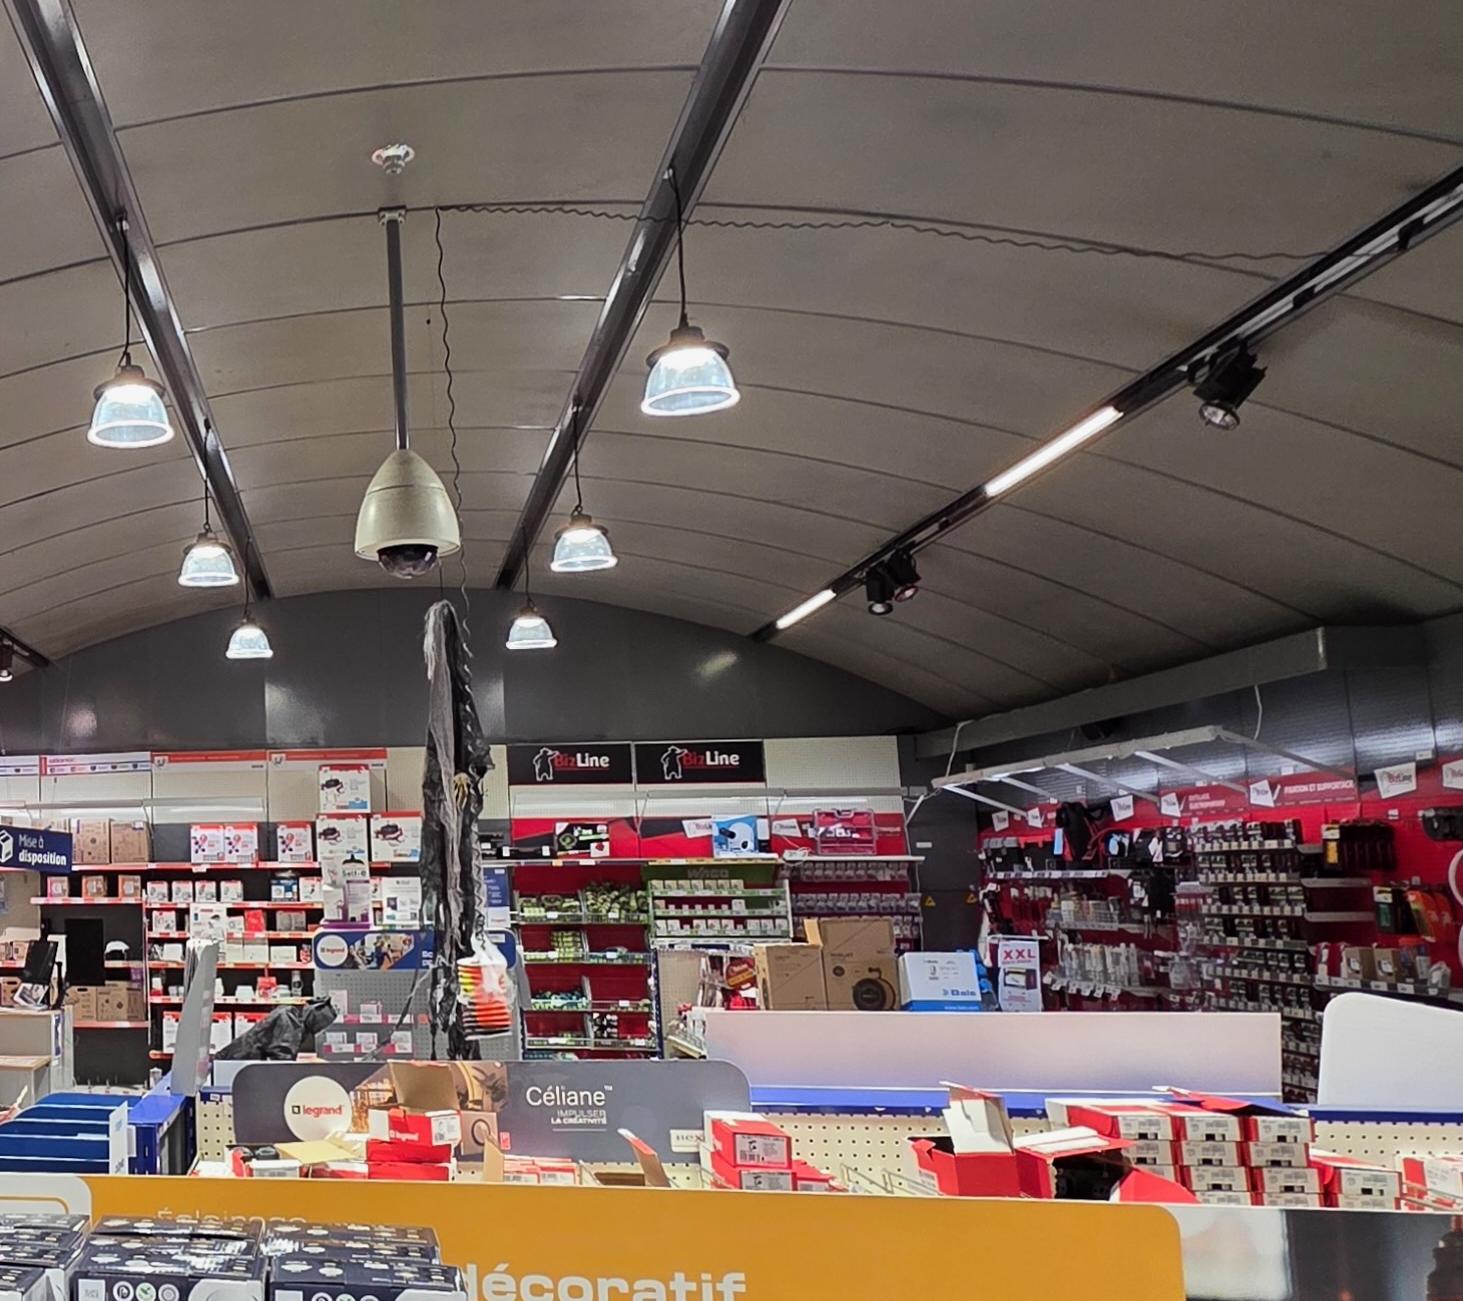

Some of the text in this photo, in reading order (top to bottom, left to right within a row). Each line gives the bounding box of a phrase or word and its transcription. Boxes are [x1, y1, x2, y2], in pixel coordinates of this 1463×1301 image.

[554, 751, 610, 768] BizLine
[682, 749, 740, 766] BizLine
[19, 834, 44, 848] Mise à
[19, 851, 67, 866] disposition
[1004, 949, 1036, 961] XXL
[526, 1086, 606, 1107] Céliane
[303, 1103, 344, 1117] legrand
